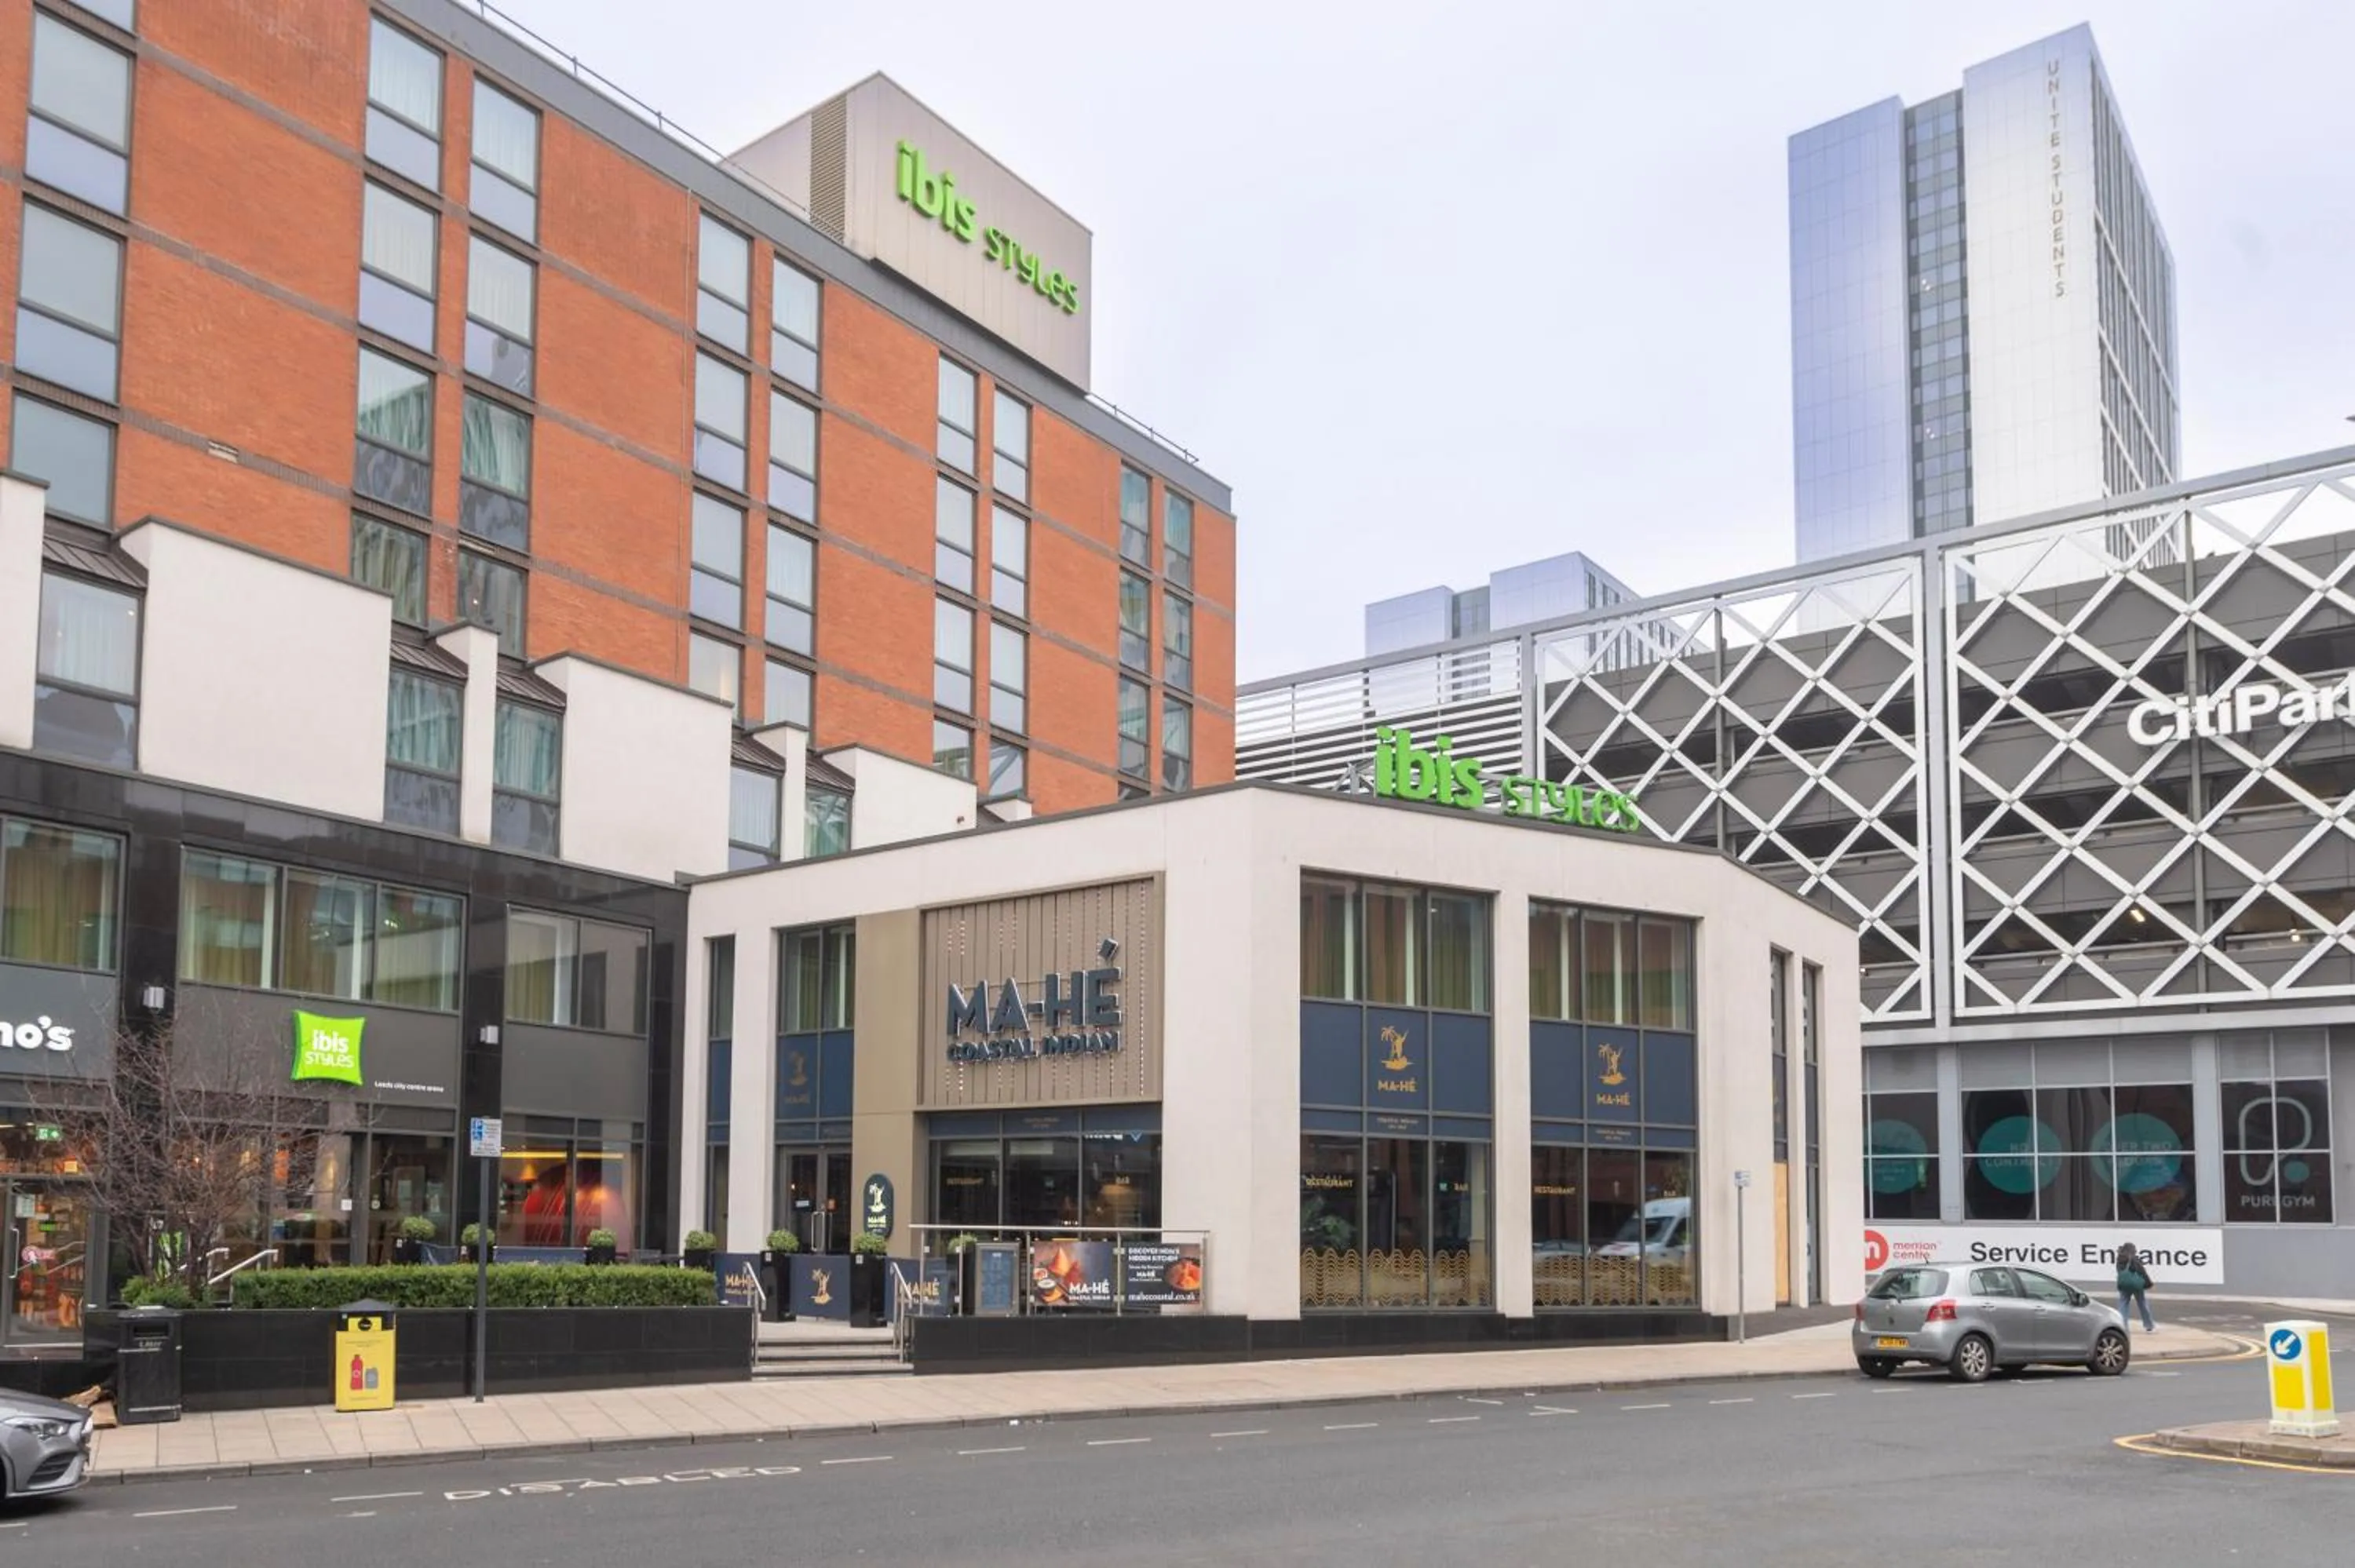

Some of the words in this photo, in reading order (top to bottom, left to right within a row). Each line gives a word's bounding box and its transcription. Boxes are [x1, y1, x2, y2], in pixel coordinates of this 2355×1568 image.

[2047, 60, 2060, 148] UNITE
[896, 139, 980, 242] ibis
[2051, 154, 2066, 297] STUDENTS
[1375, 726, 1484, 809] ibis
[947, 938, 1123, 1037] MA-HÉ
[312, 1029, 349, 1053] ibis
[947, 1037, 1039, 1063] COASTAL
[1042, 1030, 1122, 1056] INDIAN
[374, 1080, 392, 1089] Leeds
[394, 1081, 405, 1091] city
[1893, 1242, 1937, 1250] merrion
[1893, 1251, 1931, 1260] centre
[1970, 1242, 2068, 1264] Service
[2081, 1243, 2207, 1267] Enance
[1069, 1278, 1110, 1294] MA-HÉ
